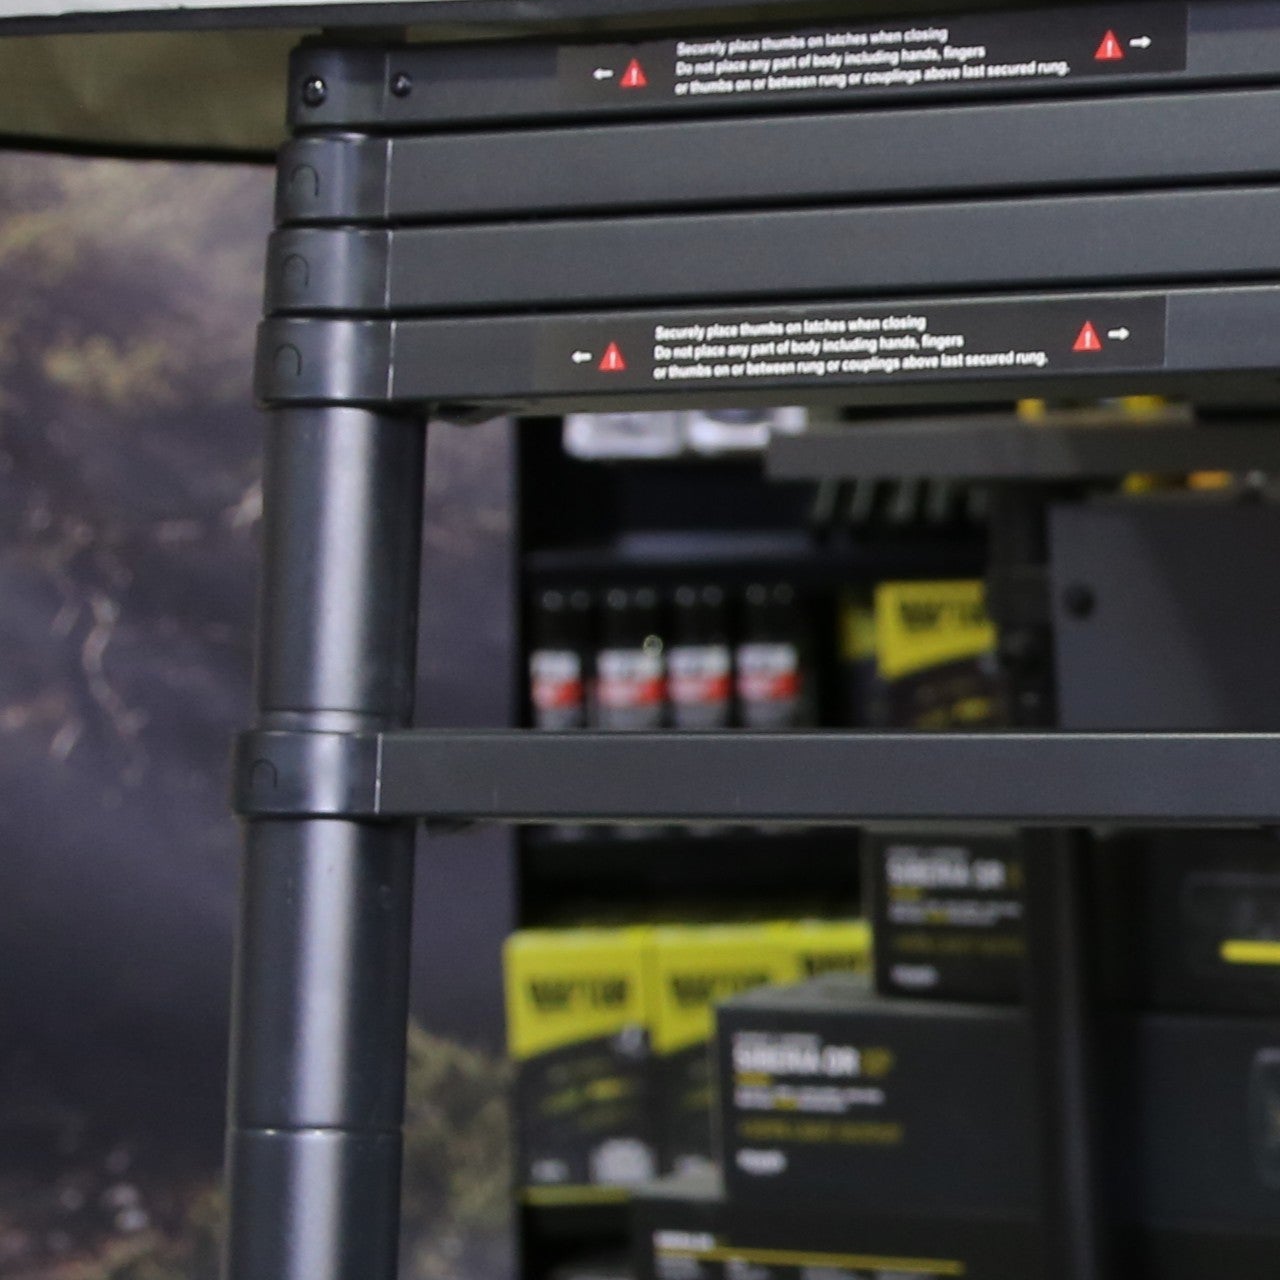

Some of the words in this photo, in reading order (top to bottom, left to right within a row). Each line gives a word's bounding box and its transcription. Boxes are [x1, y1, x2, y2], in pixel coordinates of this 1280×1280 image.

[676, 41, 727, 57] Securely
[728, 39, 760, 56] place
[761, 36, 806, 51] thumbs
[807, 36, 824, 48] on
[825, 32, 868, 47] latches
[870, 30, 902, 45] when
[904, 27, 949, 43] closing
[675, 61, 693, 76] Do
[694, 60, 714, 74] not
[716, 59, 747, 76] place
[749, 59, 771, 74] any
[772, 56, 797, 72] part
[798, 54, 812, 68] of
[813, 52, 843, 69] body
[844, 51, 899, 66] including
[901, 46, 941, 62] hands,
[943, 45, 986, 62] fingers
[674, 83, 689, 95] or
[690, 80, 734, 95] thumbs
[735, 79, 751, 92] on
[752, 78, 766, 91] or
[767, 75, 817, 90] between
[818, 74, 847, 89] rung
[848, 73, 862, 85] or
[864, 69, 922, 85] couplings
[923, 67, 961, 81] above
[962, 64, 985, 79] last
[986, 61, 1037, 78] secured
[1037, 61, 1070, 77] rung.
[655, 325, 705, 341] Securely
[706, 323, 738, 340] place
[740, 322, 784, 337] thumbs
[785, 322, 802, 335] on
[803, 319, 846, 334] latches
[848, 317, 881, 332] when
[882, 315, 926, 332] closing
[654, 345, 672, 360] Do
[673, 345, 693, 359] not
[694, 344, 726, 360] place
[727, 345, 749, 359] any
[750, 341, 775, 358] part
[776, 339, 790, 355] of
[791, 339, 821, 356] body
[822, 337, 878, 354] including
[879, 335, 920, 351] hands,
[921, 334, 964, 351] fingers
[653, 367, 667, 380] or
[668, 364, 712, 379] thumbs
[714, 364, 730, 377] on
[731, 363, 745, 376] or
[746, 361, 795, 375] between
[797, 360, 825, 376] rung
[826, 360, 841, 373] or
[842, 356, 900, 373] couplings
[902, 355, 939, 369] above
[940, 353, 964, 368] last
[965, 350, 1015, 367] secured
[1016, 351, 1048, 367] rung.
